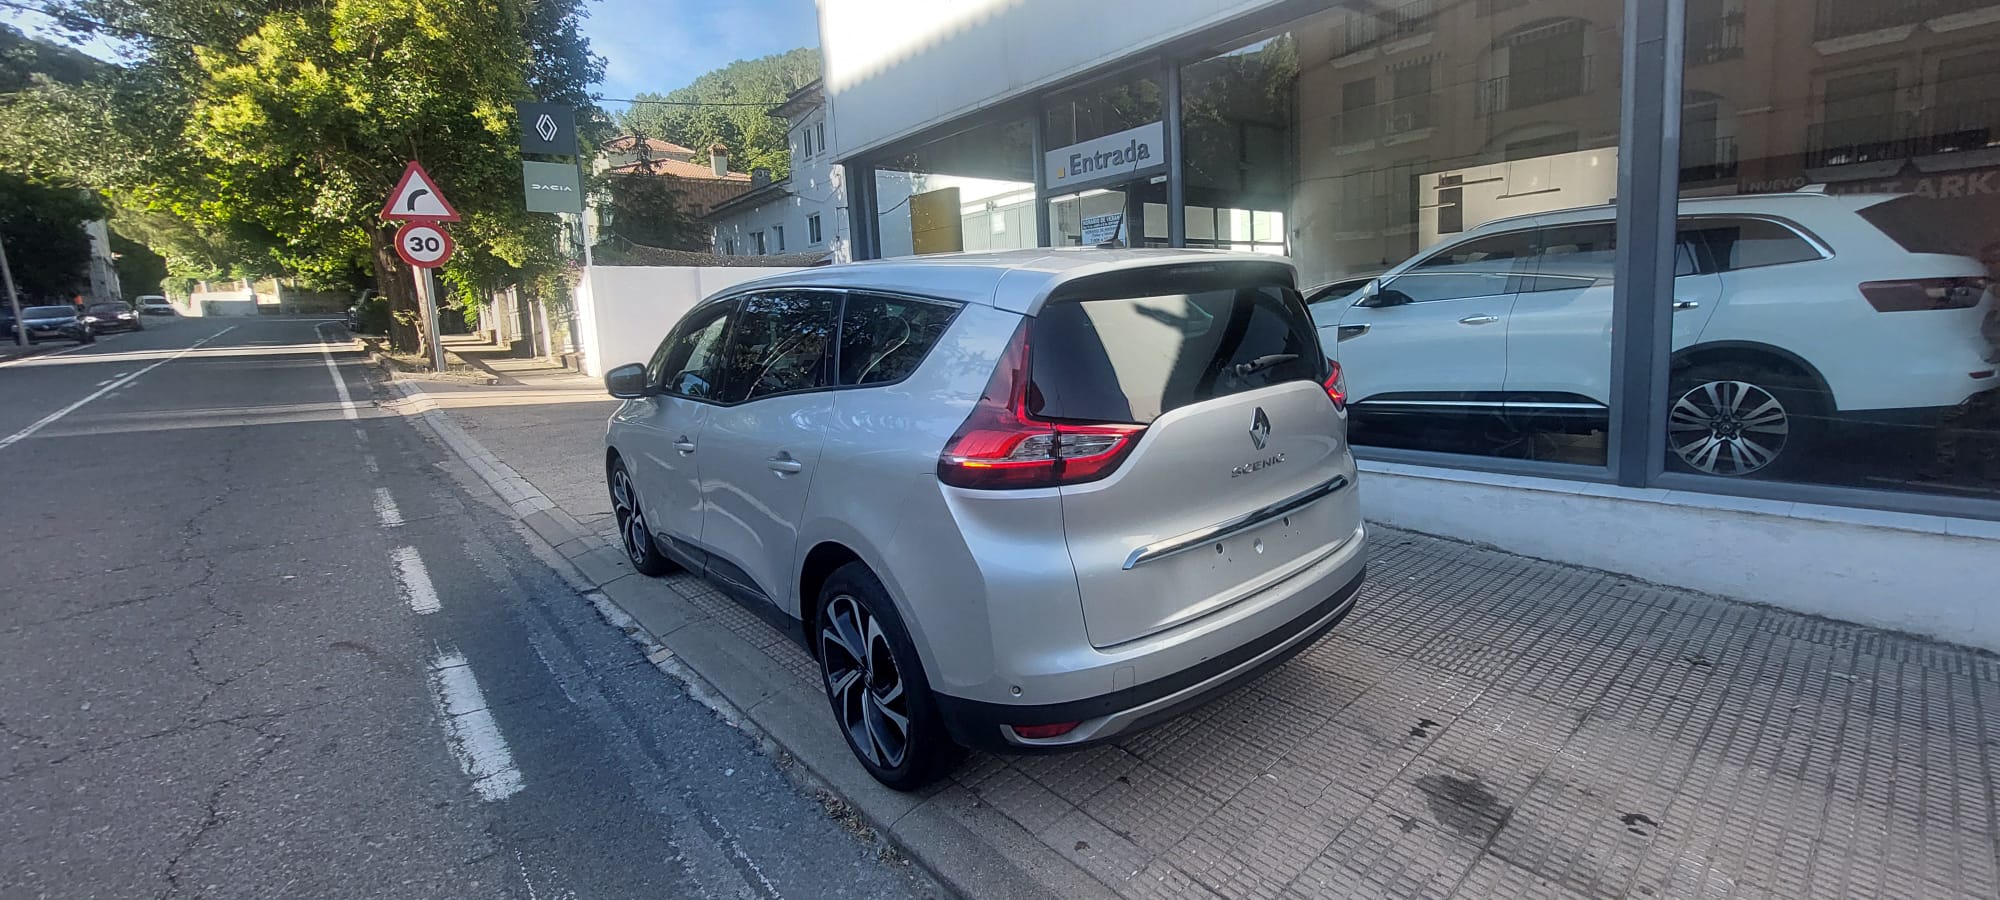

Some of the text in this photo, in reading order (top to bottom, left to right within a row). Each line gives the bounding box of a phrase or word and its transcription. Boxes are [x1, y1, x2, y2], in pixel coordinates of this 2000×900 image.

[1069, 139, 1150, 176] Entrada
[531, 183, 572, 192] DACIA
[1750, 176, 1805, 192] NUEVO
[1913, 171, 2000, 199] ARK
[410, 236, 440, 253] 30
[1231, 453, 1286, 478] SCENIC
